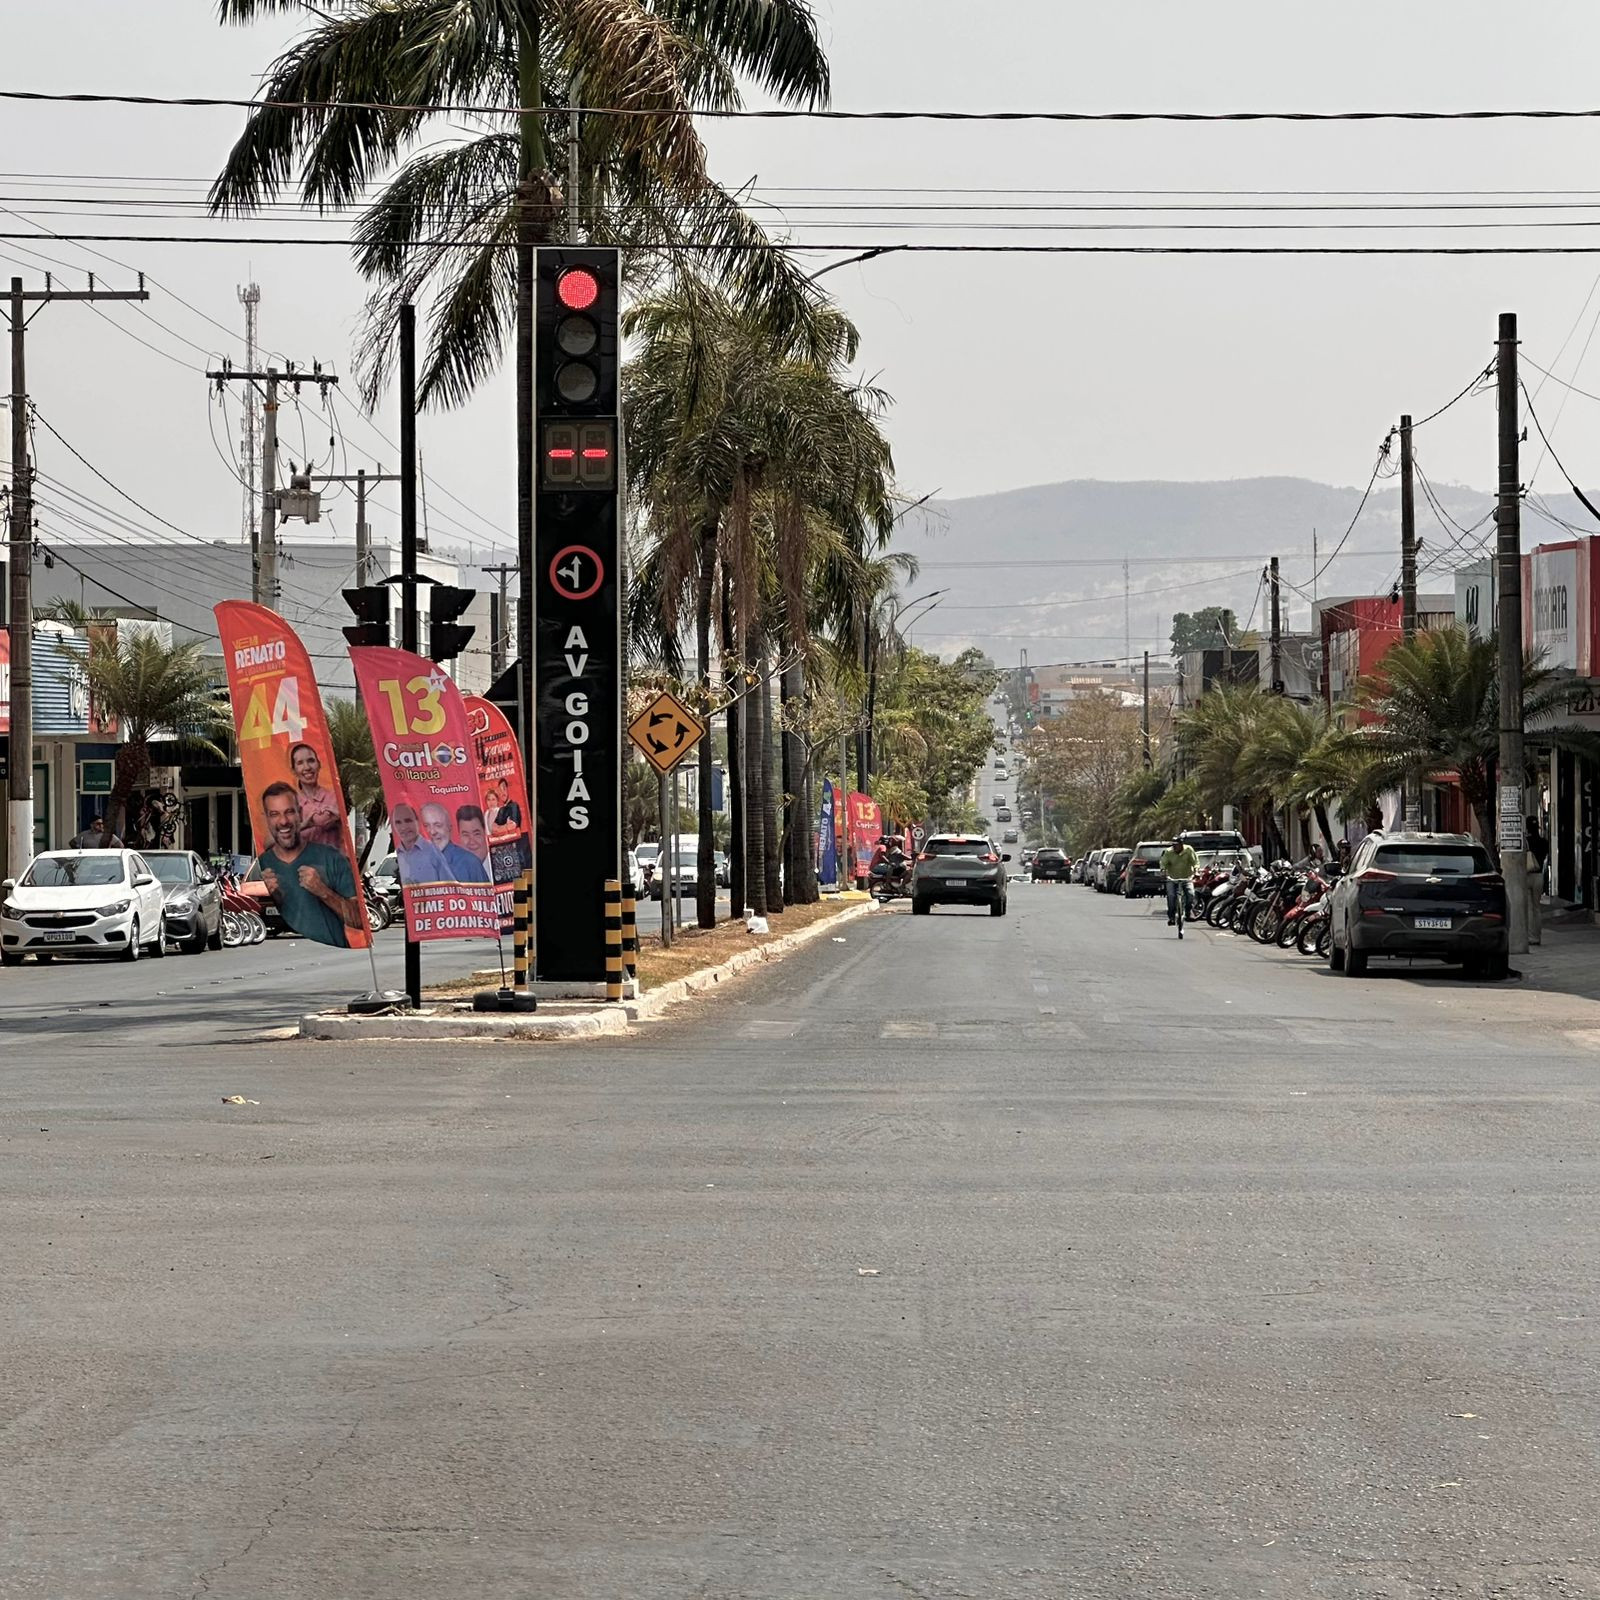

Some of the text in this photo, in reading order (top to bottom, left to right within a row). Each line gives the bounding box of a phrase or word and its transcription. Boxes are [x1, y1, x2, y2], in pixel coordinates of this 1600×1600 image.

[234, 640, 286, 670] RENATO
[240, 676, 308, 749] 44
[378, 675, 447, 735] 13
[564, 625, 591, 830] AV GOIÁS
[406, 767, 441, 781] Itapuã
[429, 784, 470, 795] Toquinho
[856, 802, 876, 820] 13
[413, 900, 444, 914] TIME
[449, 898, 466, 911] DO
[415, 918, 431, 932] DE
[436, 914, 500, 930] GOIANÉSIA
